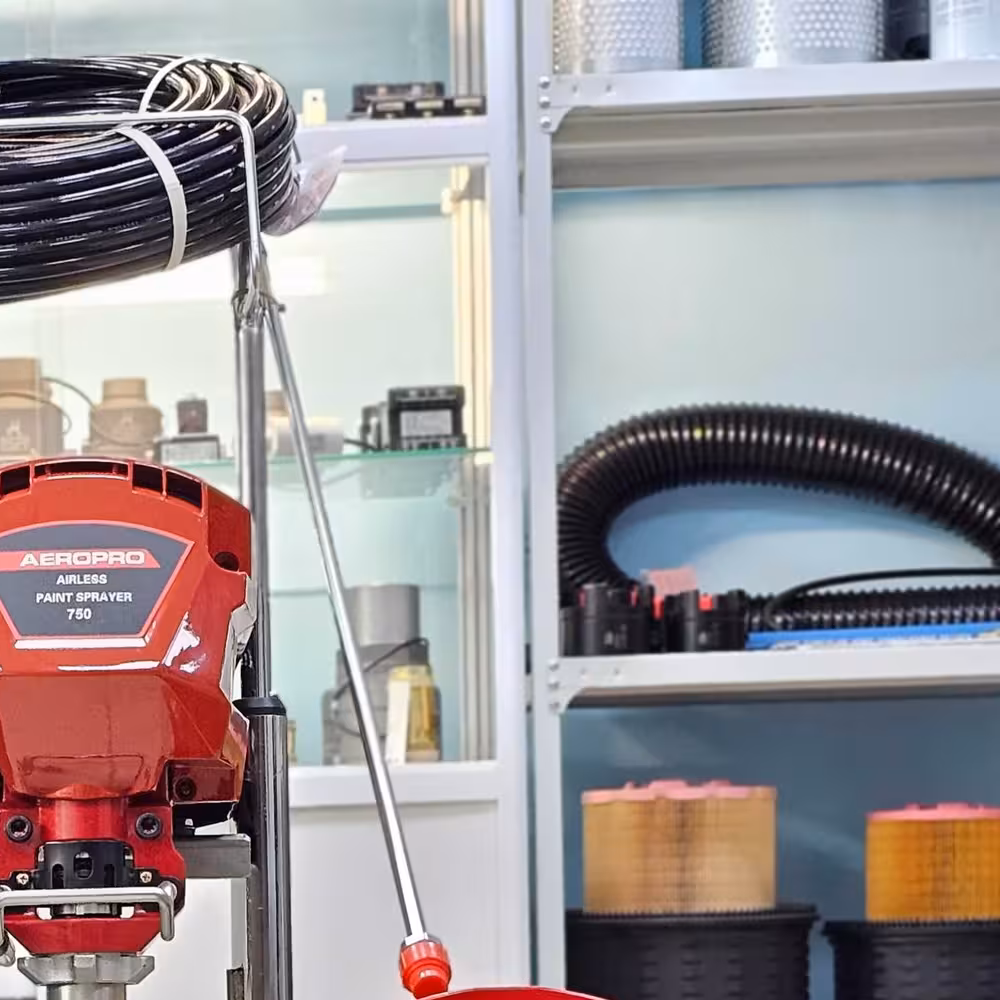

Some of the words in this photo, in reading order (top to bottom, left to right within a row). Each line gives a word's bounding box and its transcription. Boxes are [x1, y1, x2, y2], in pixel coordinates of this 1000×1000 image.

[19, 551, 146, 567] AEROPRO
[56, 574, 107, 585] AIRLESS
[36, 592, 73, 603] PAINT
[75, 592, 133, 602] SPRAYER
[67, 608, 92, 620] 750
